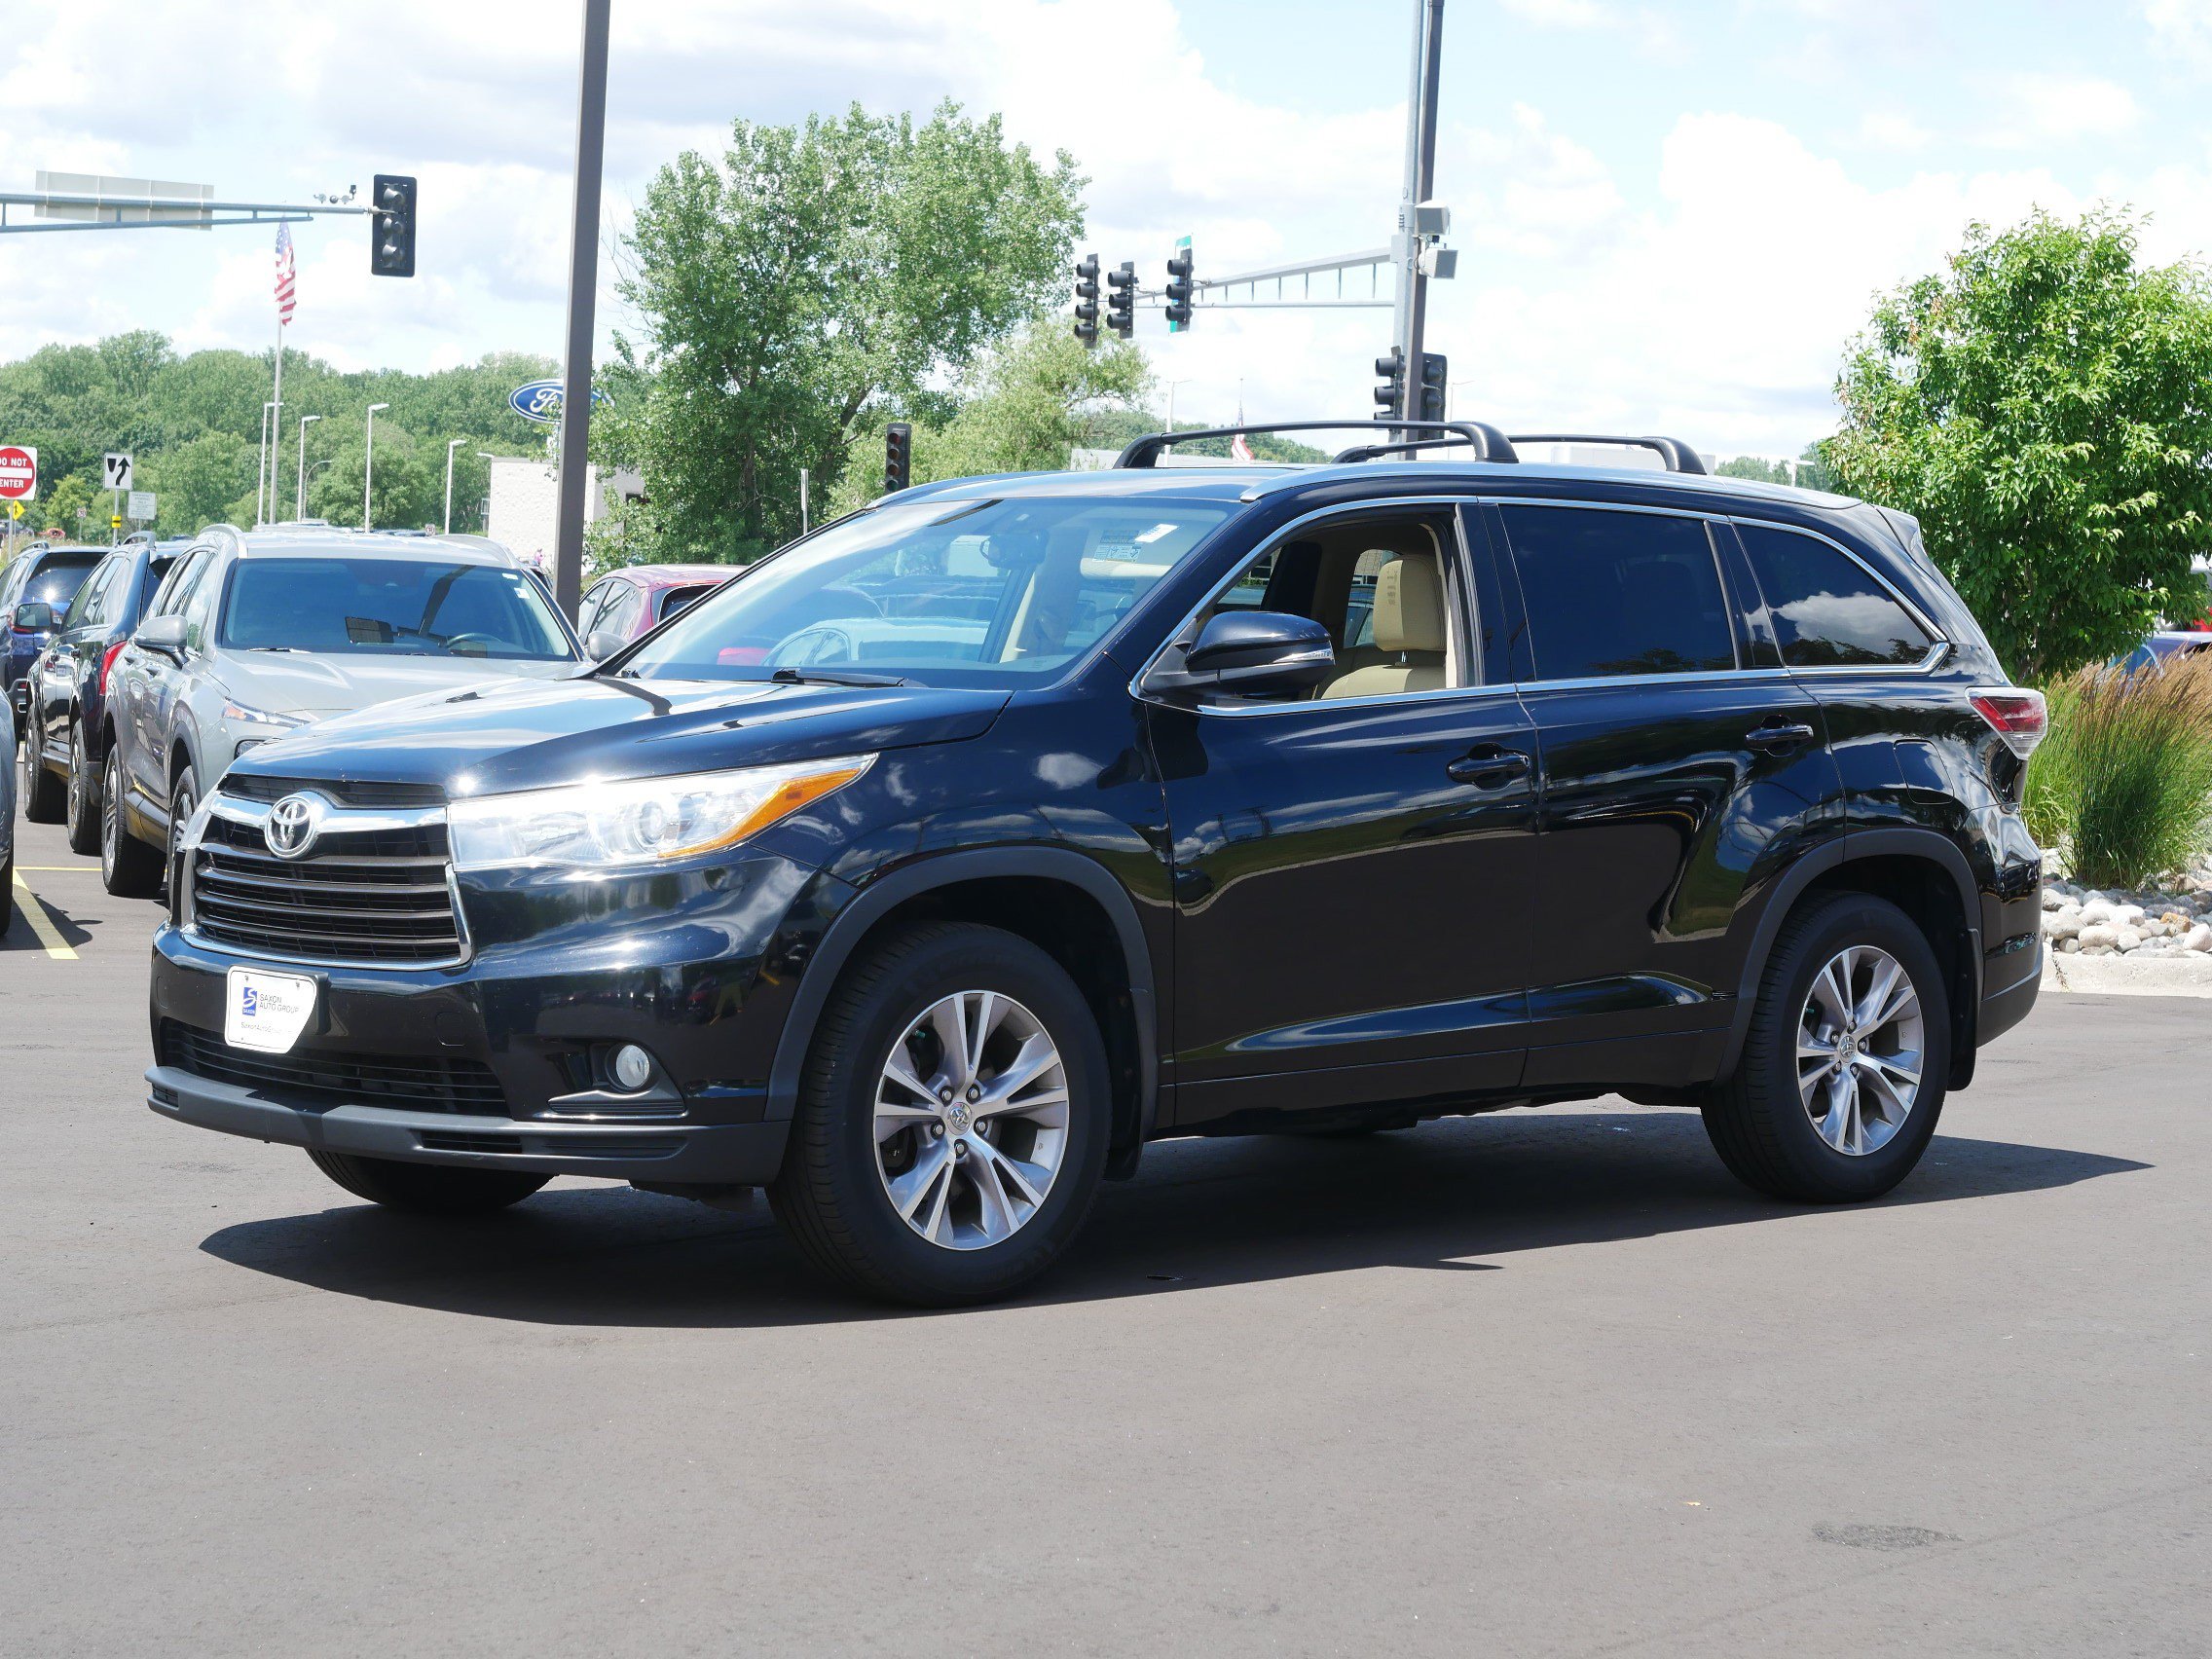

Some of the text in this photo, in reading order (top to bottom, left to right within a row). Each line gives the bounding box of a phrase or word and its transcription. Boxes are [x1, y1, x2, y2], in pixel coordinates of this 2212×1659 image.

[0, 458, 27, 466] O NOT
[259, 993, 282, 1003] SAXON
[259, 1002, 299, 1014] AUTO GROUP
